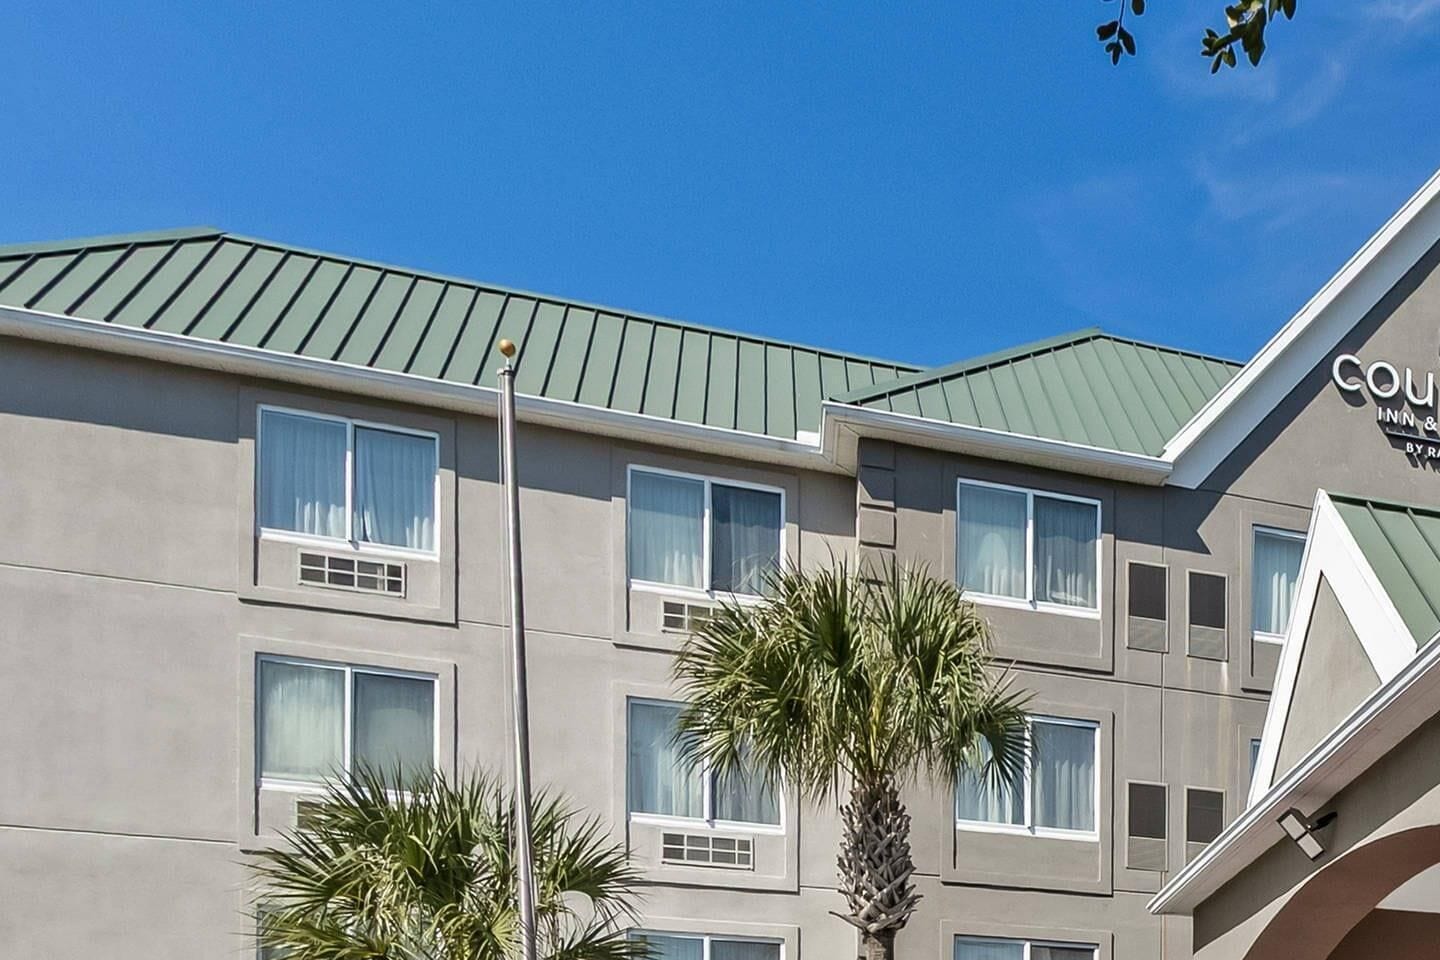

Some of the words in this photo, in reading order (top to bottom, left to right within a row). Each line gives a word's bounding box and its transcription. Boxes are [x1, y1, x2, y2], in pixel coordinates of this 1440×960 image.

[1377, 406, 1414, 427] INN
[1424, 416, 1437, 432] &
[1406, 442, 1423, 454] BY
